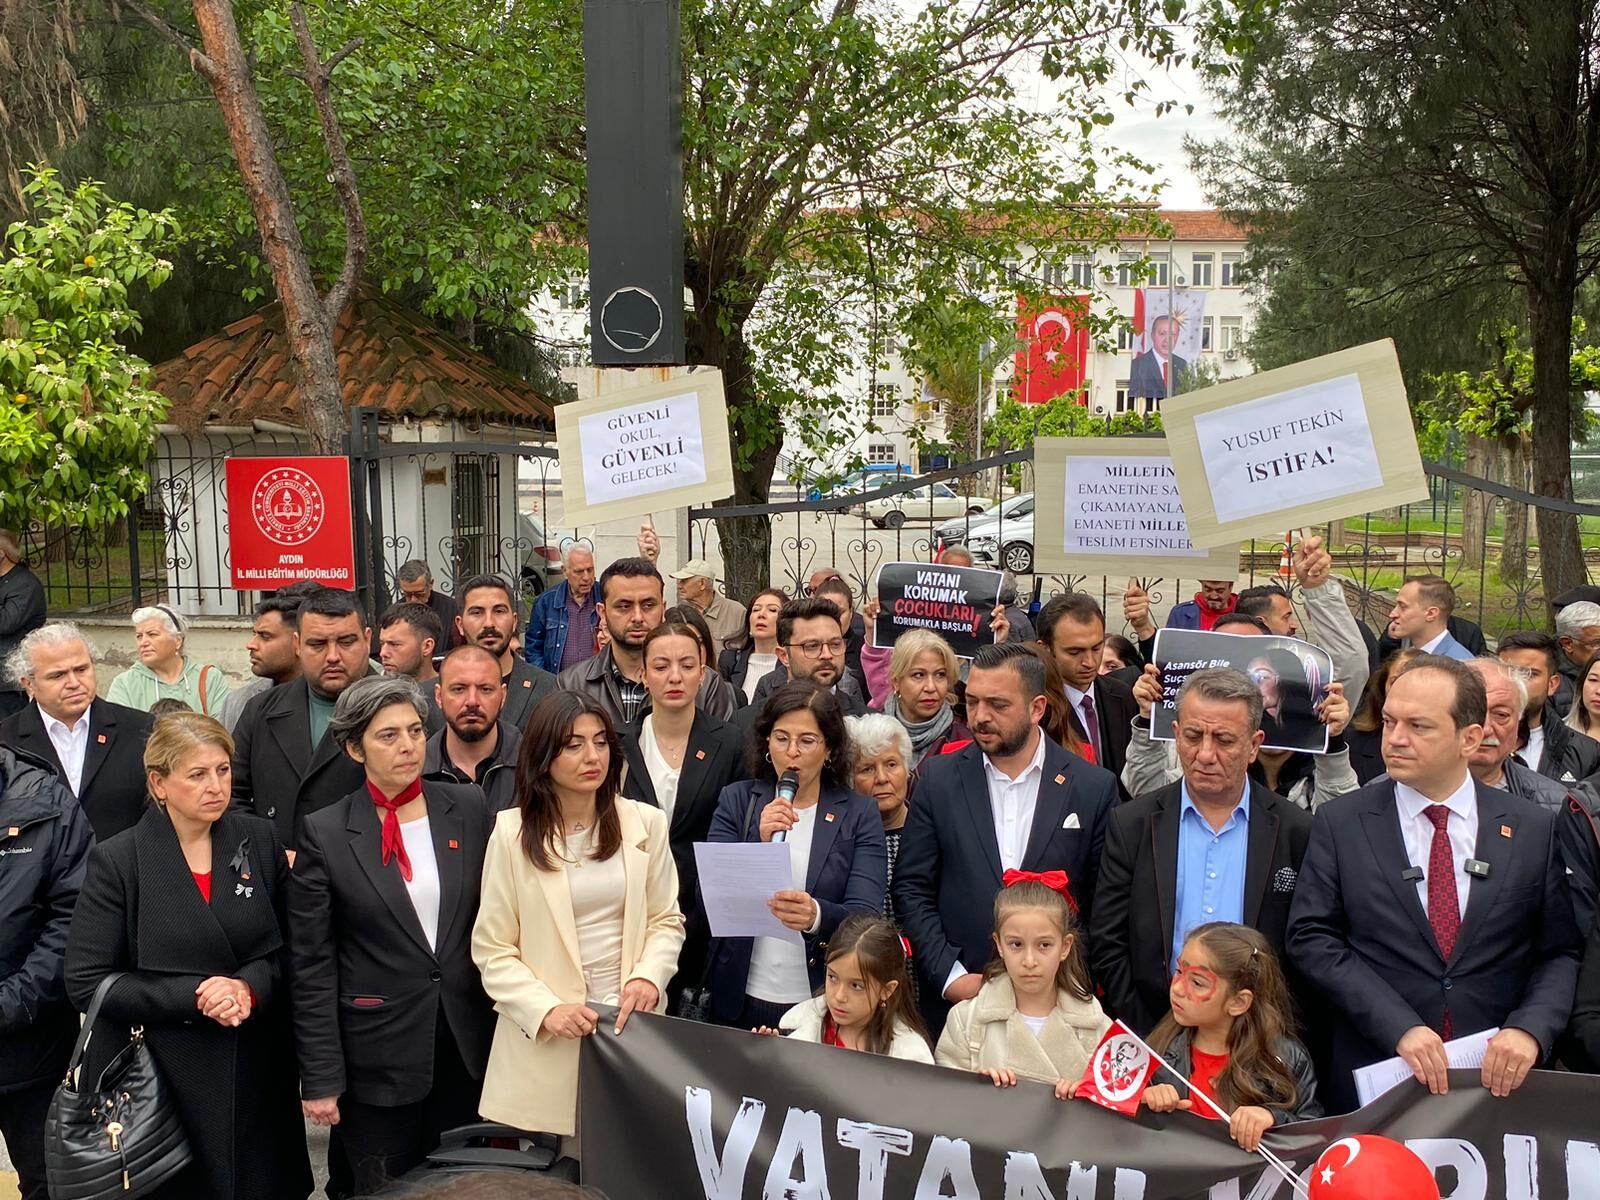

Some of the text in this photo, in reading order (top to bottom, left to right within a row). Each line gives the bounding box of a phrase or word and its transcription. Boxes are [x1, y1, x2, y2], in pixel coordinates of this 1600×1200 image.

[607, 405, 670, 430] GÜVENLİ
[1222, 409, 1345, 451] YUSUF TEKİN
[602, 437, 684, 469] GÜVENLİ
[1246, 446, 1336, 483] İSTİFA!
[611, 462, 677, 486] GELECEK!
[1078, 481, 1158, 495] EMANETİNE
[1080, 502, 1185, 514] ÇIKAMAYANLA
[1074, 517, 1186, 531] EMANETİ MİLLE
[1076, 535, 1126, 547] TESLİM
[278, 554, 304, 564] AYDIN
[237, 567, 349, 579] İL MİLLİ EĞİTİM MÜDÜRLÜĞÜ
[917, 570, 961, 588] VATANI
[904, 584, 968, 605] KORUMAK
[893, 615, 940, 630] KORUMAKLA
[1163, 659, 1231, 670] Asansör Bile
[1163, 699, 1176, 710] To
